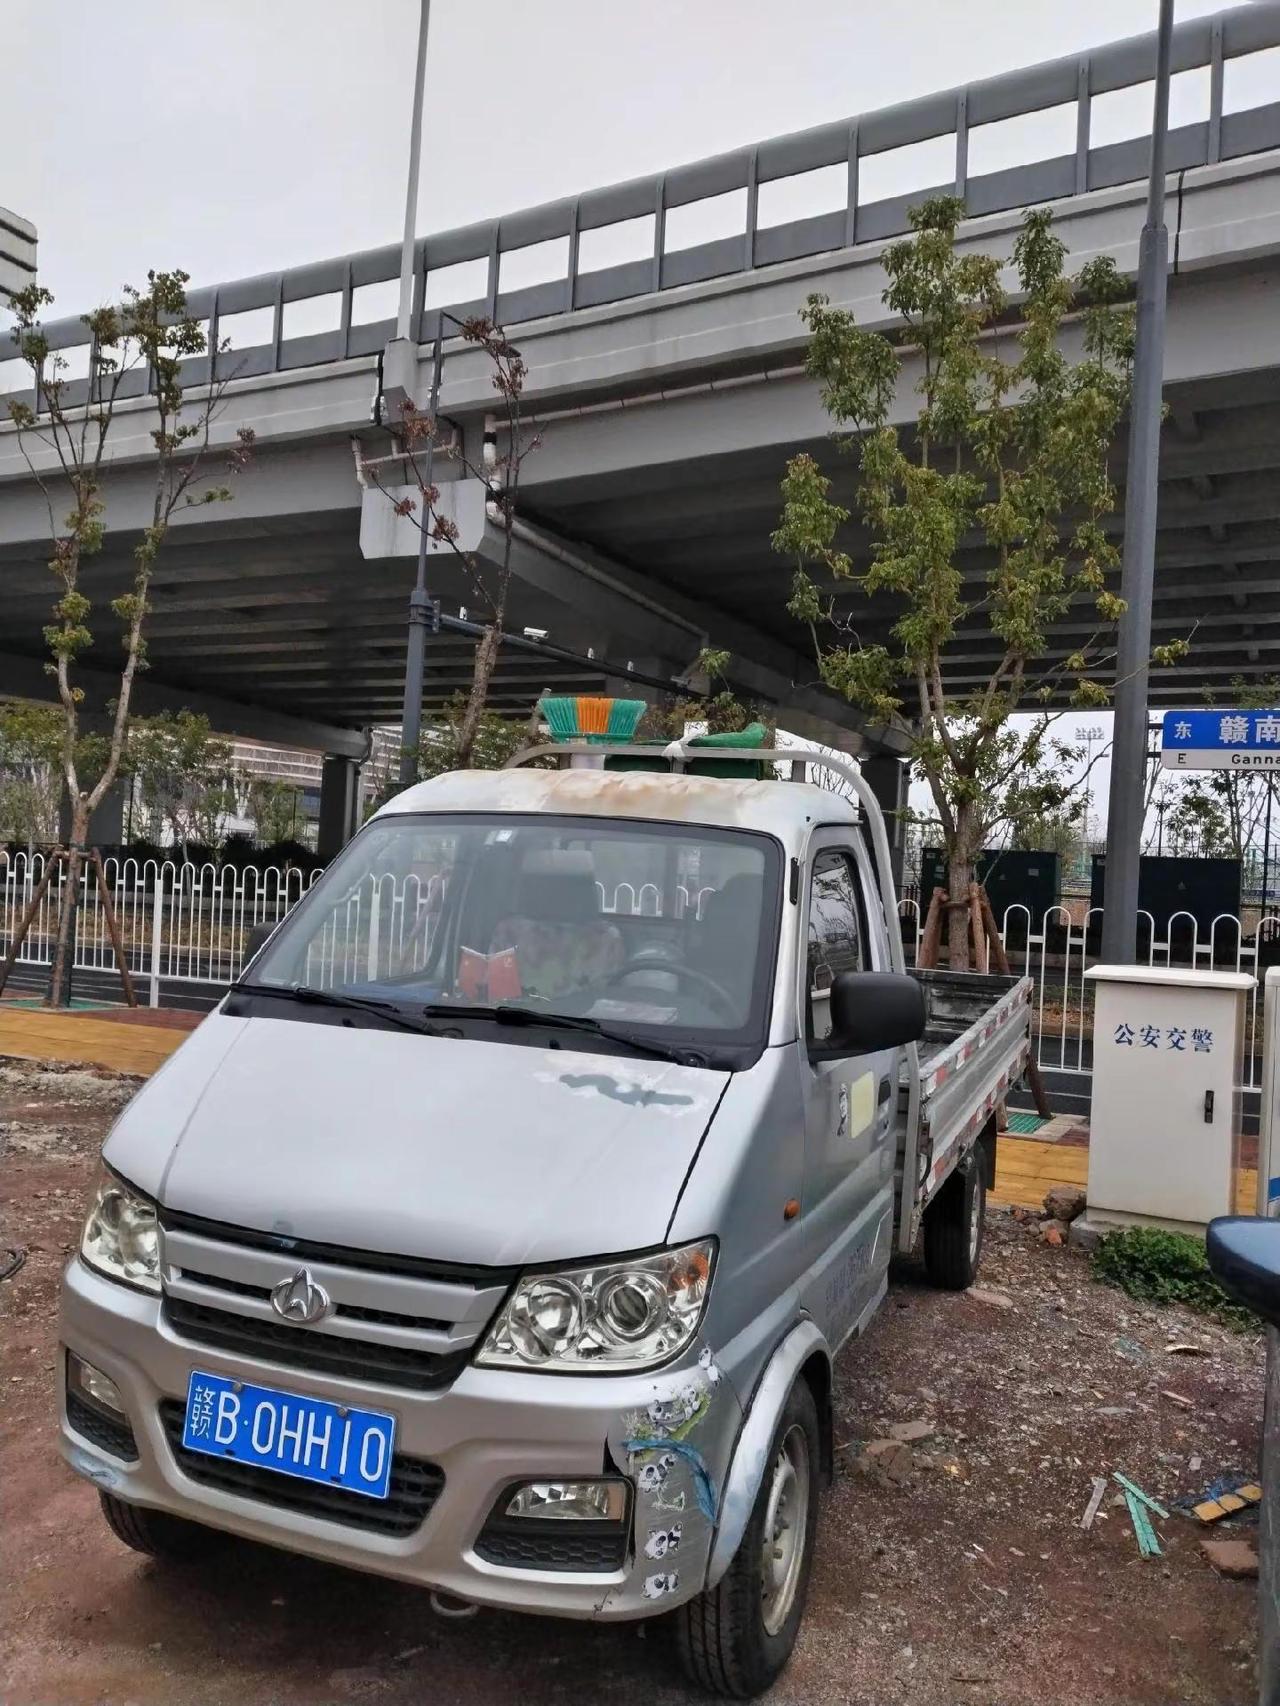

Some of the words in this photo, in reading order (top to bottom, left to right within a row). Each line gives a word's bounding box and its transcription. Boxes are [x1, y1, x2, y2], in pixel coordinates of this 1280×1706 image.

[1174, 721, 1192, 739] 东
[1219, 715, 1280, 743] 赣南
[1178, 753, 1186, 764] E
[1114, 1023, 1213, 1053] 公安交警
